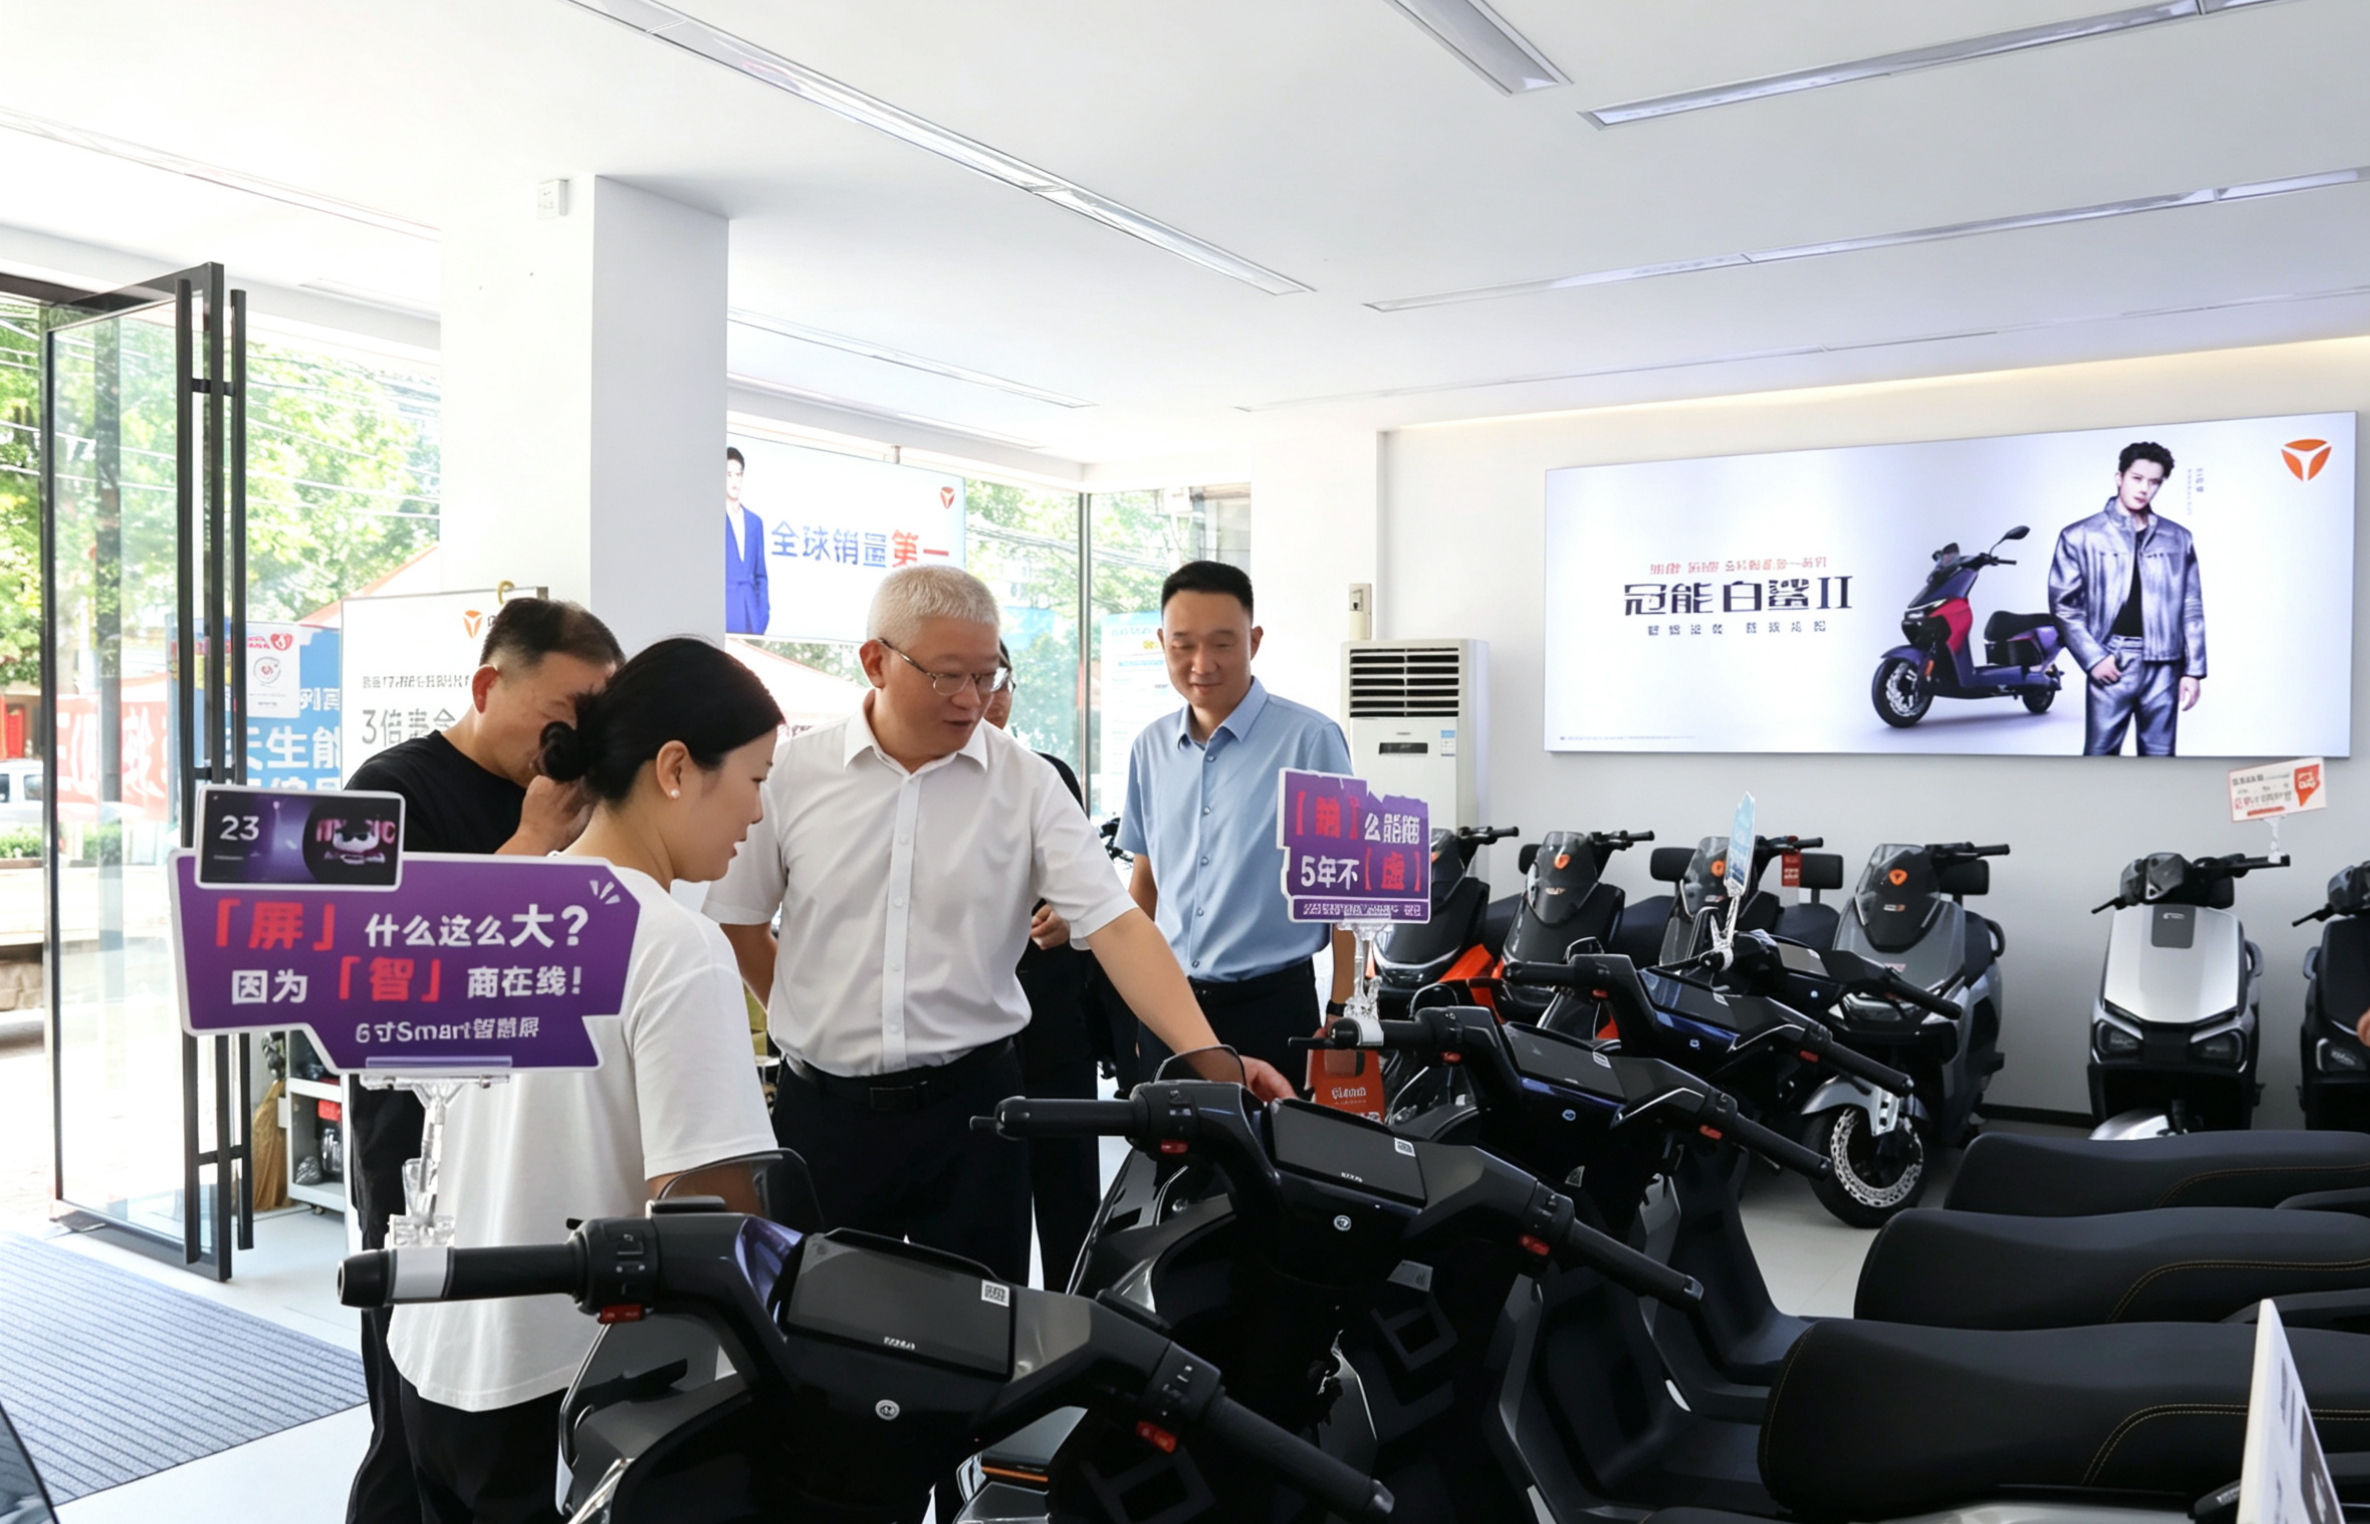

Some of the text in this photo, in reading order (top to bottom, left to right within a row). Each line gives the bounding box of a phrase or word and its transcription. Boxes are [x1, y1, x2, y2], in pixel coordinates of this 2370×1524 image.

[771, 520, 949, 568] 全球销量第一
[219, 815, 260, 841] 23
